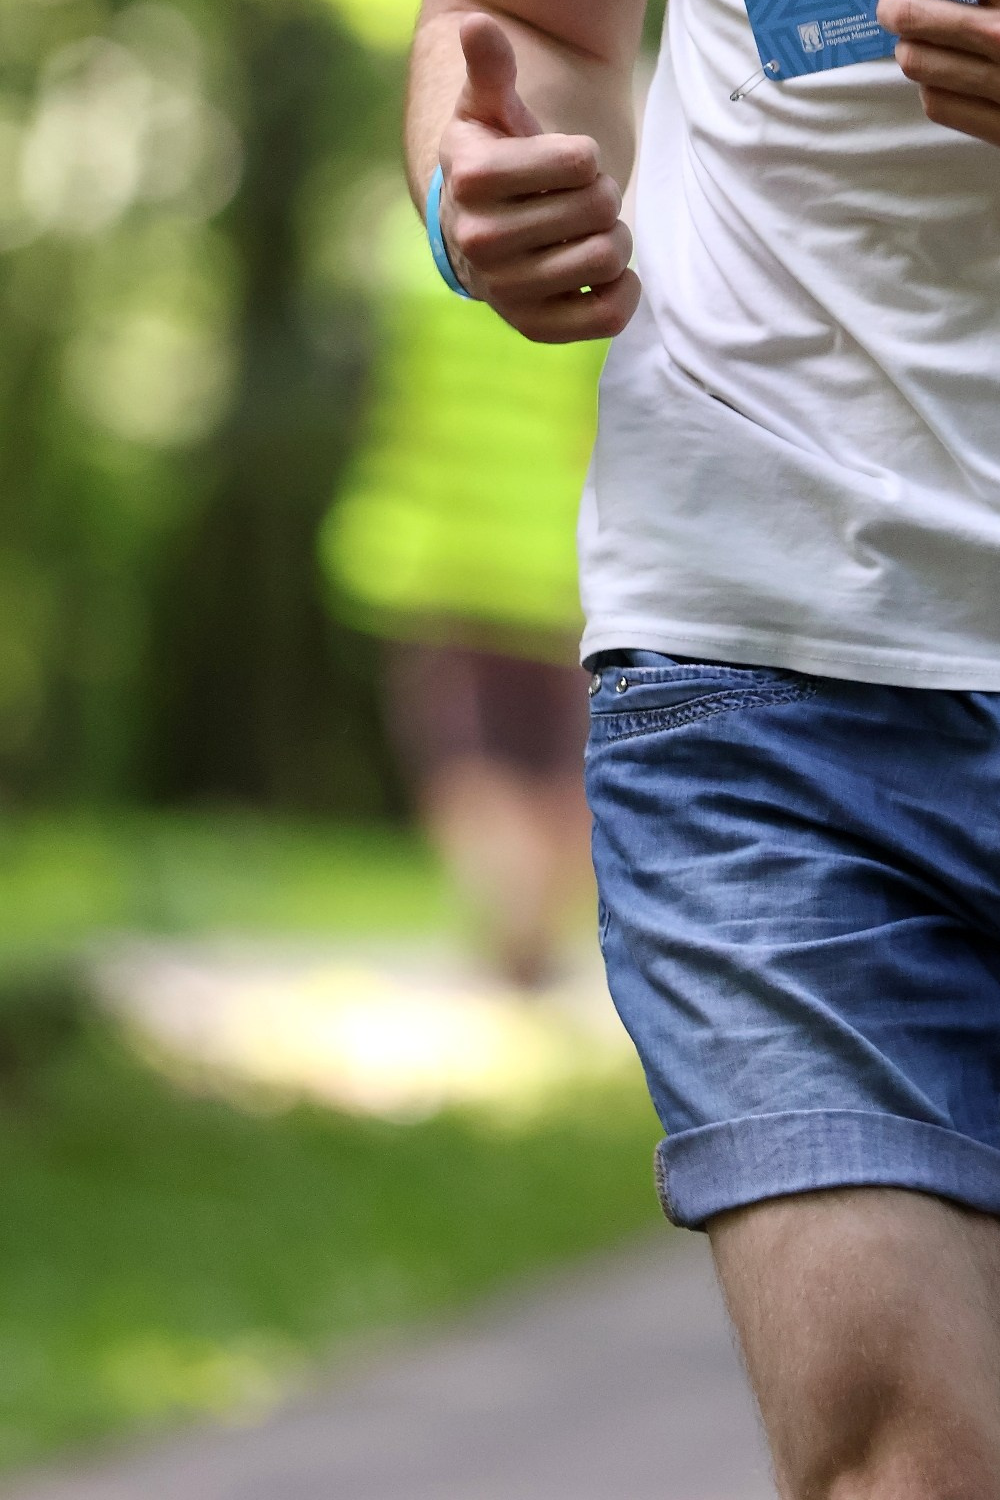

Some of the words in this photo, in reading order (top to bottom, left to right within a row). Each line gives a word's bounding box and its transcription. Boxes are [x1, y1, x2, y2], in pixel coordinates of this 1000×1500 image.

[822, 13, 867, 30] Департамент
[825, 20, 880, 38] здравоохранен
[826, 36, 850, 46] города
[851, 28, 880, 40] Москвы
